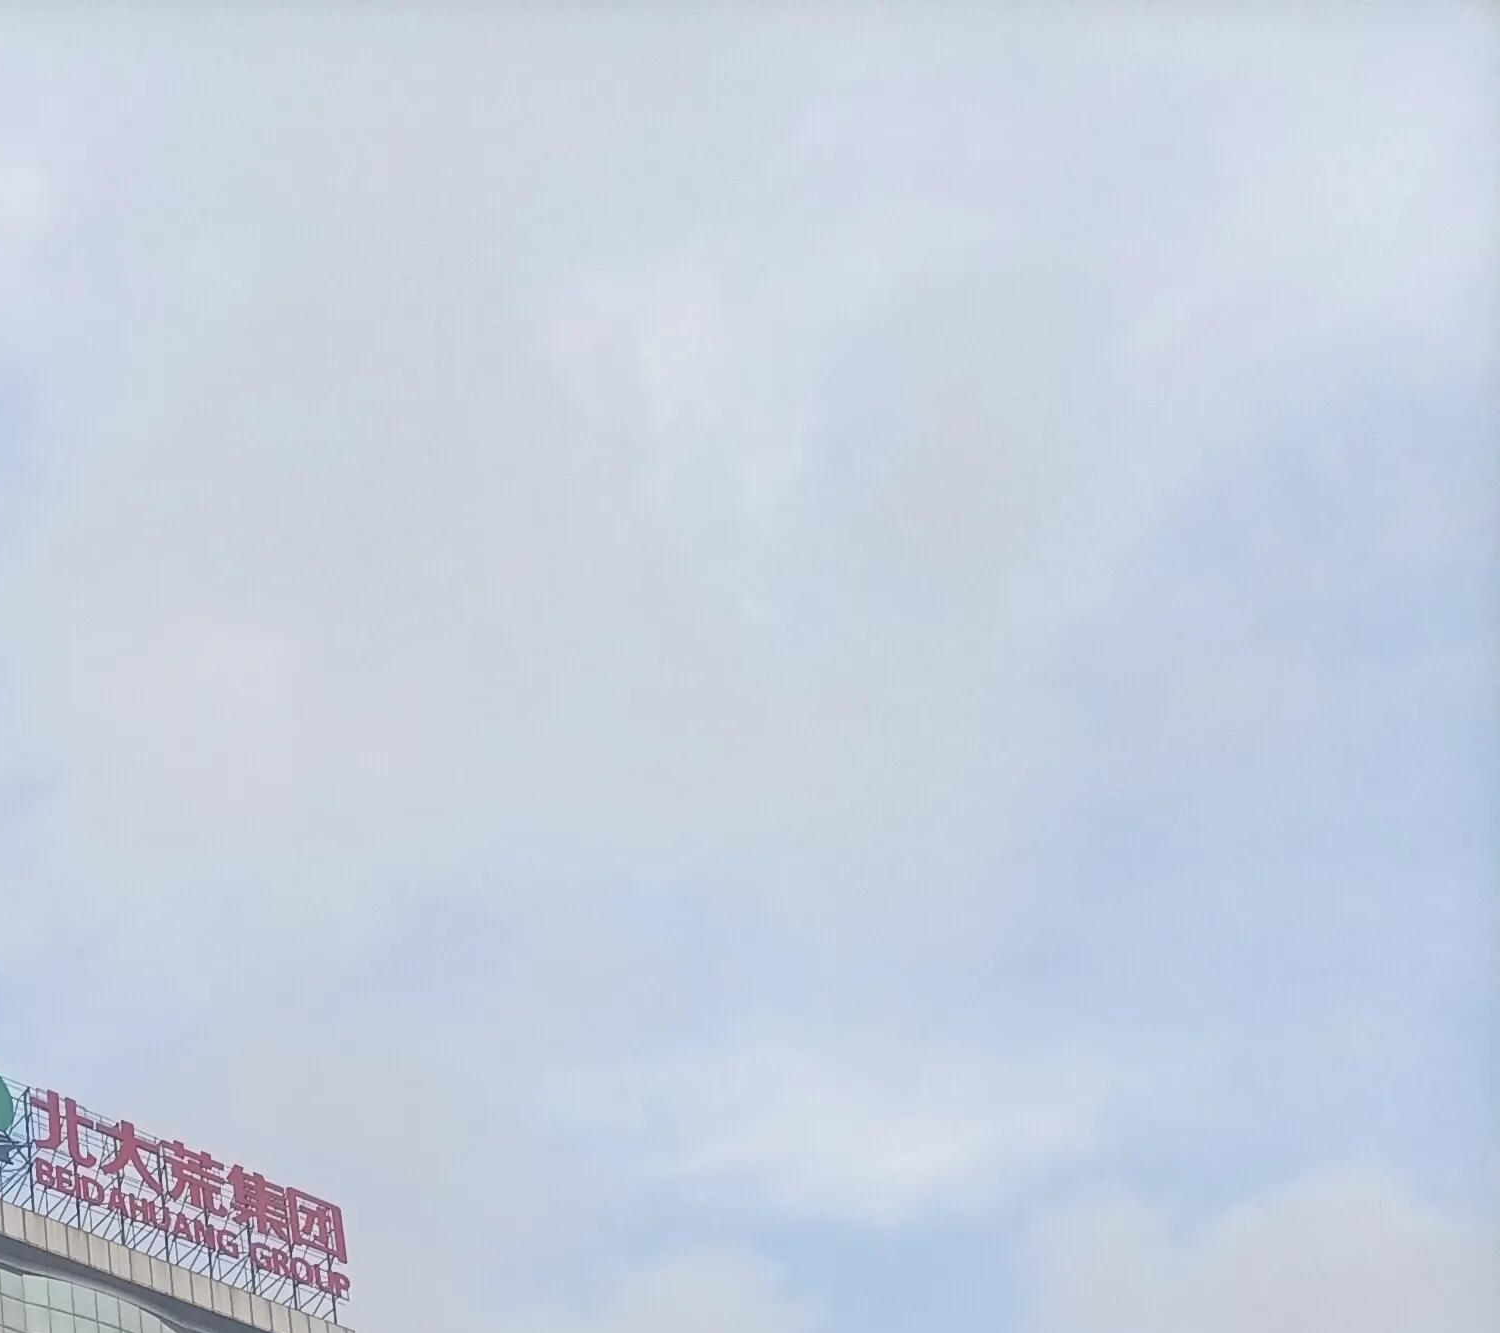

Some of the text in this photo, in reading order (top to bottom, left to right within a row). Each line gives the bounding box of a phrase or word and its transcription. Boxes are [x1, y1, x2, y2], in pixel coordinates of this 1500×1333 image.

[30, 1089, 347, 1264] 北大荒集团
[35, 1157, 351, 1300] BEIDAHUANG GROUP
